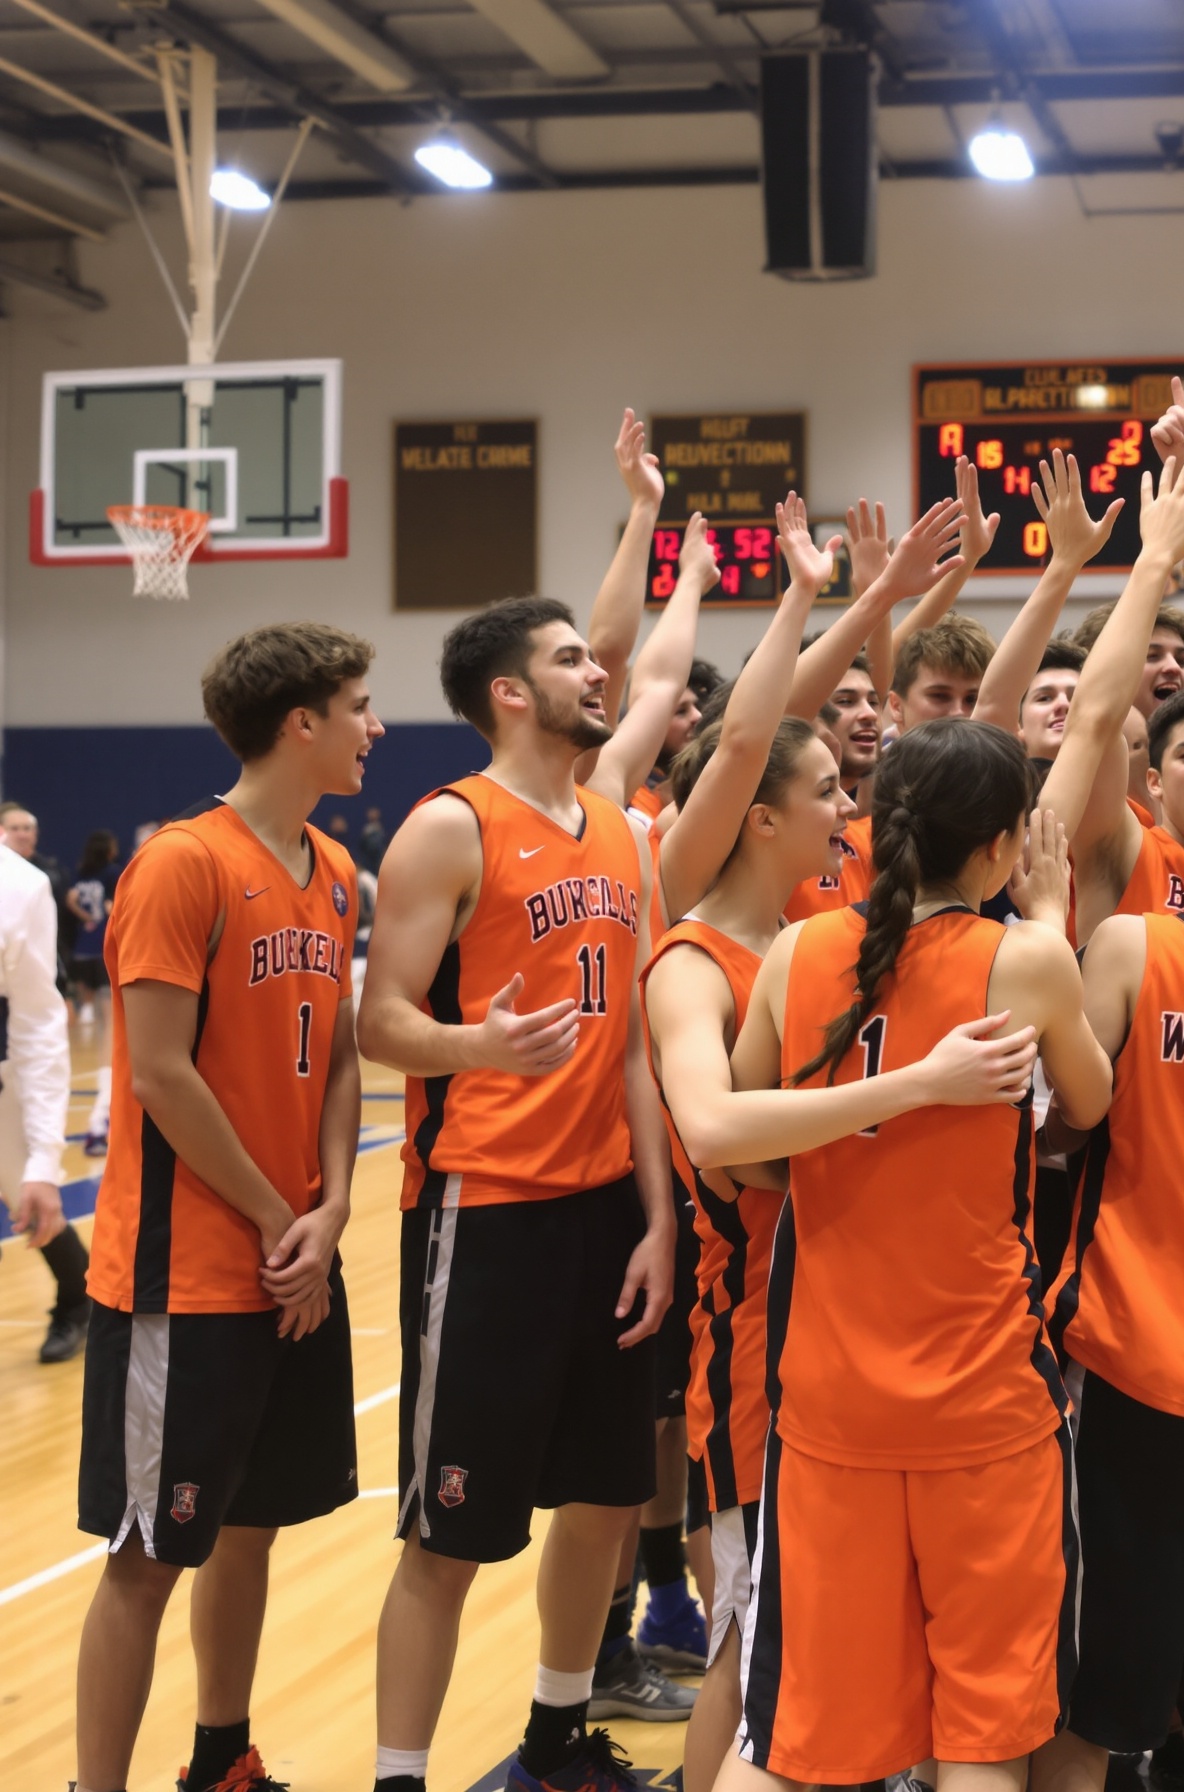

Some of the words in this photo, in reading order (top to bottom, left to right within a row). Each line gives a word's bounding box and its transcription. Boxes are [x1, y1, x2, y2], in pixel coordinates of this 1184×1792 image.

[733, 527, 772, 560] 52
[575, 943, 608, 1017] 11
[295, 1001, 313, 1078] 1
[856, 1014, 888, 1138] 1
